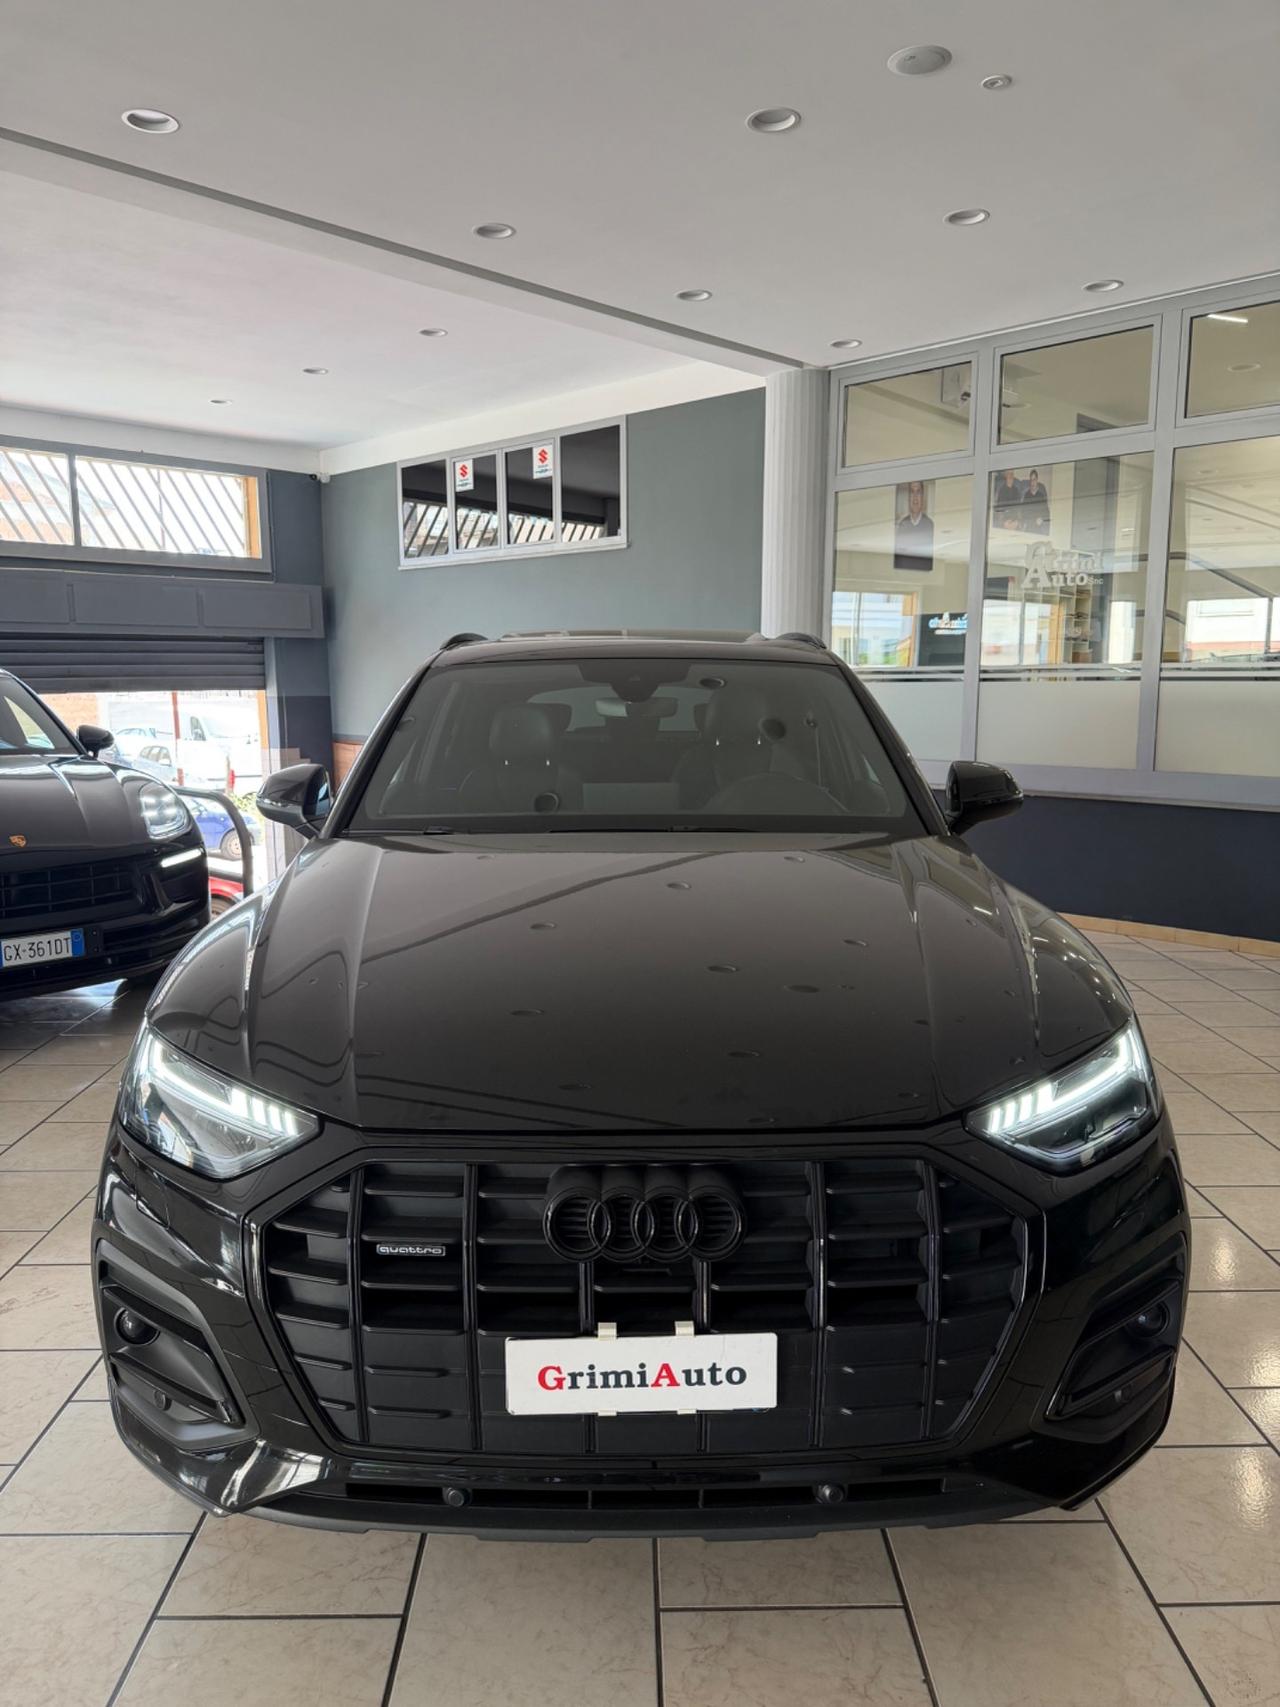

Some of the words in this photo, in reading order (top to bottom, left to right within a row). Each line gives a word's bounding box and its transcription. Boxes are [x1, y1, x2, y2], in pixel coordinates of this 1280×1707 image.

[1021, 556, 1088, 588] Auto
[380, 1246, 442, 1255] quattro
[538, 1362, 747, 1390] GrimiAuto
